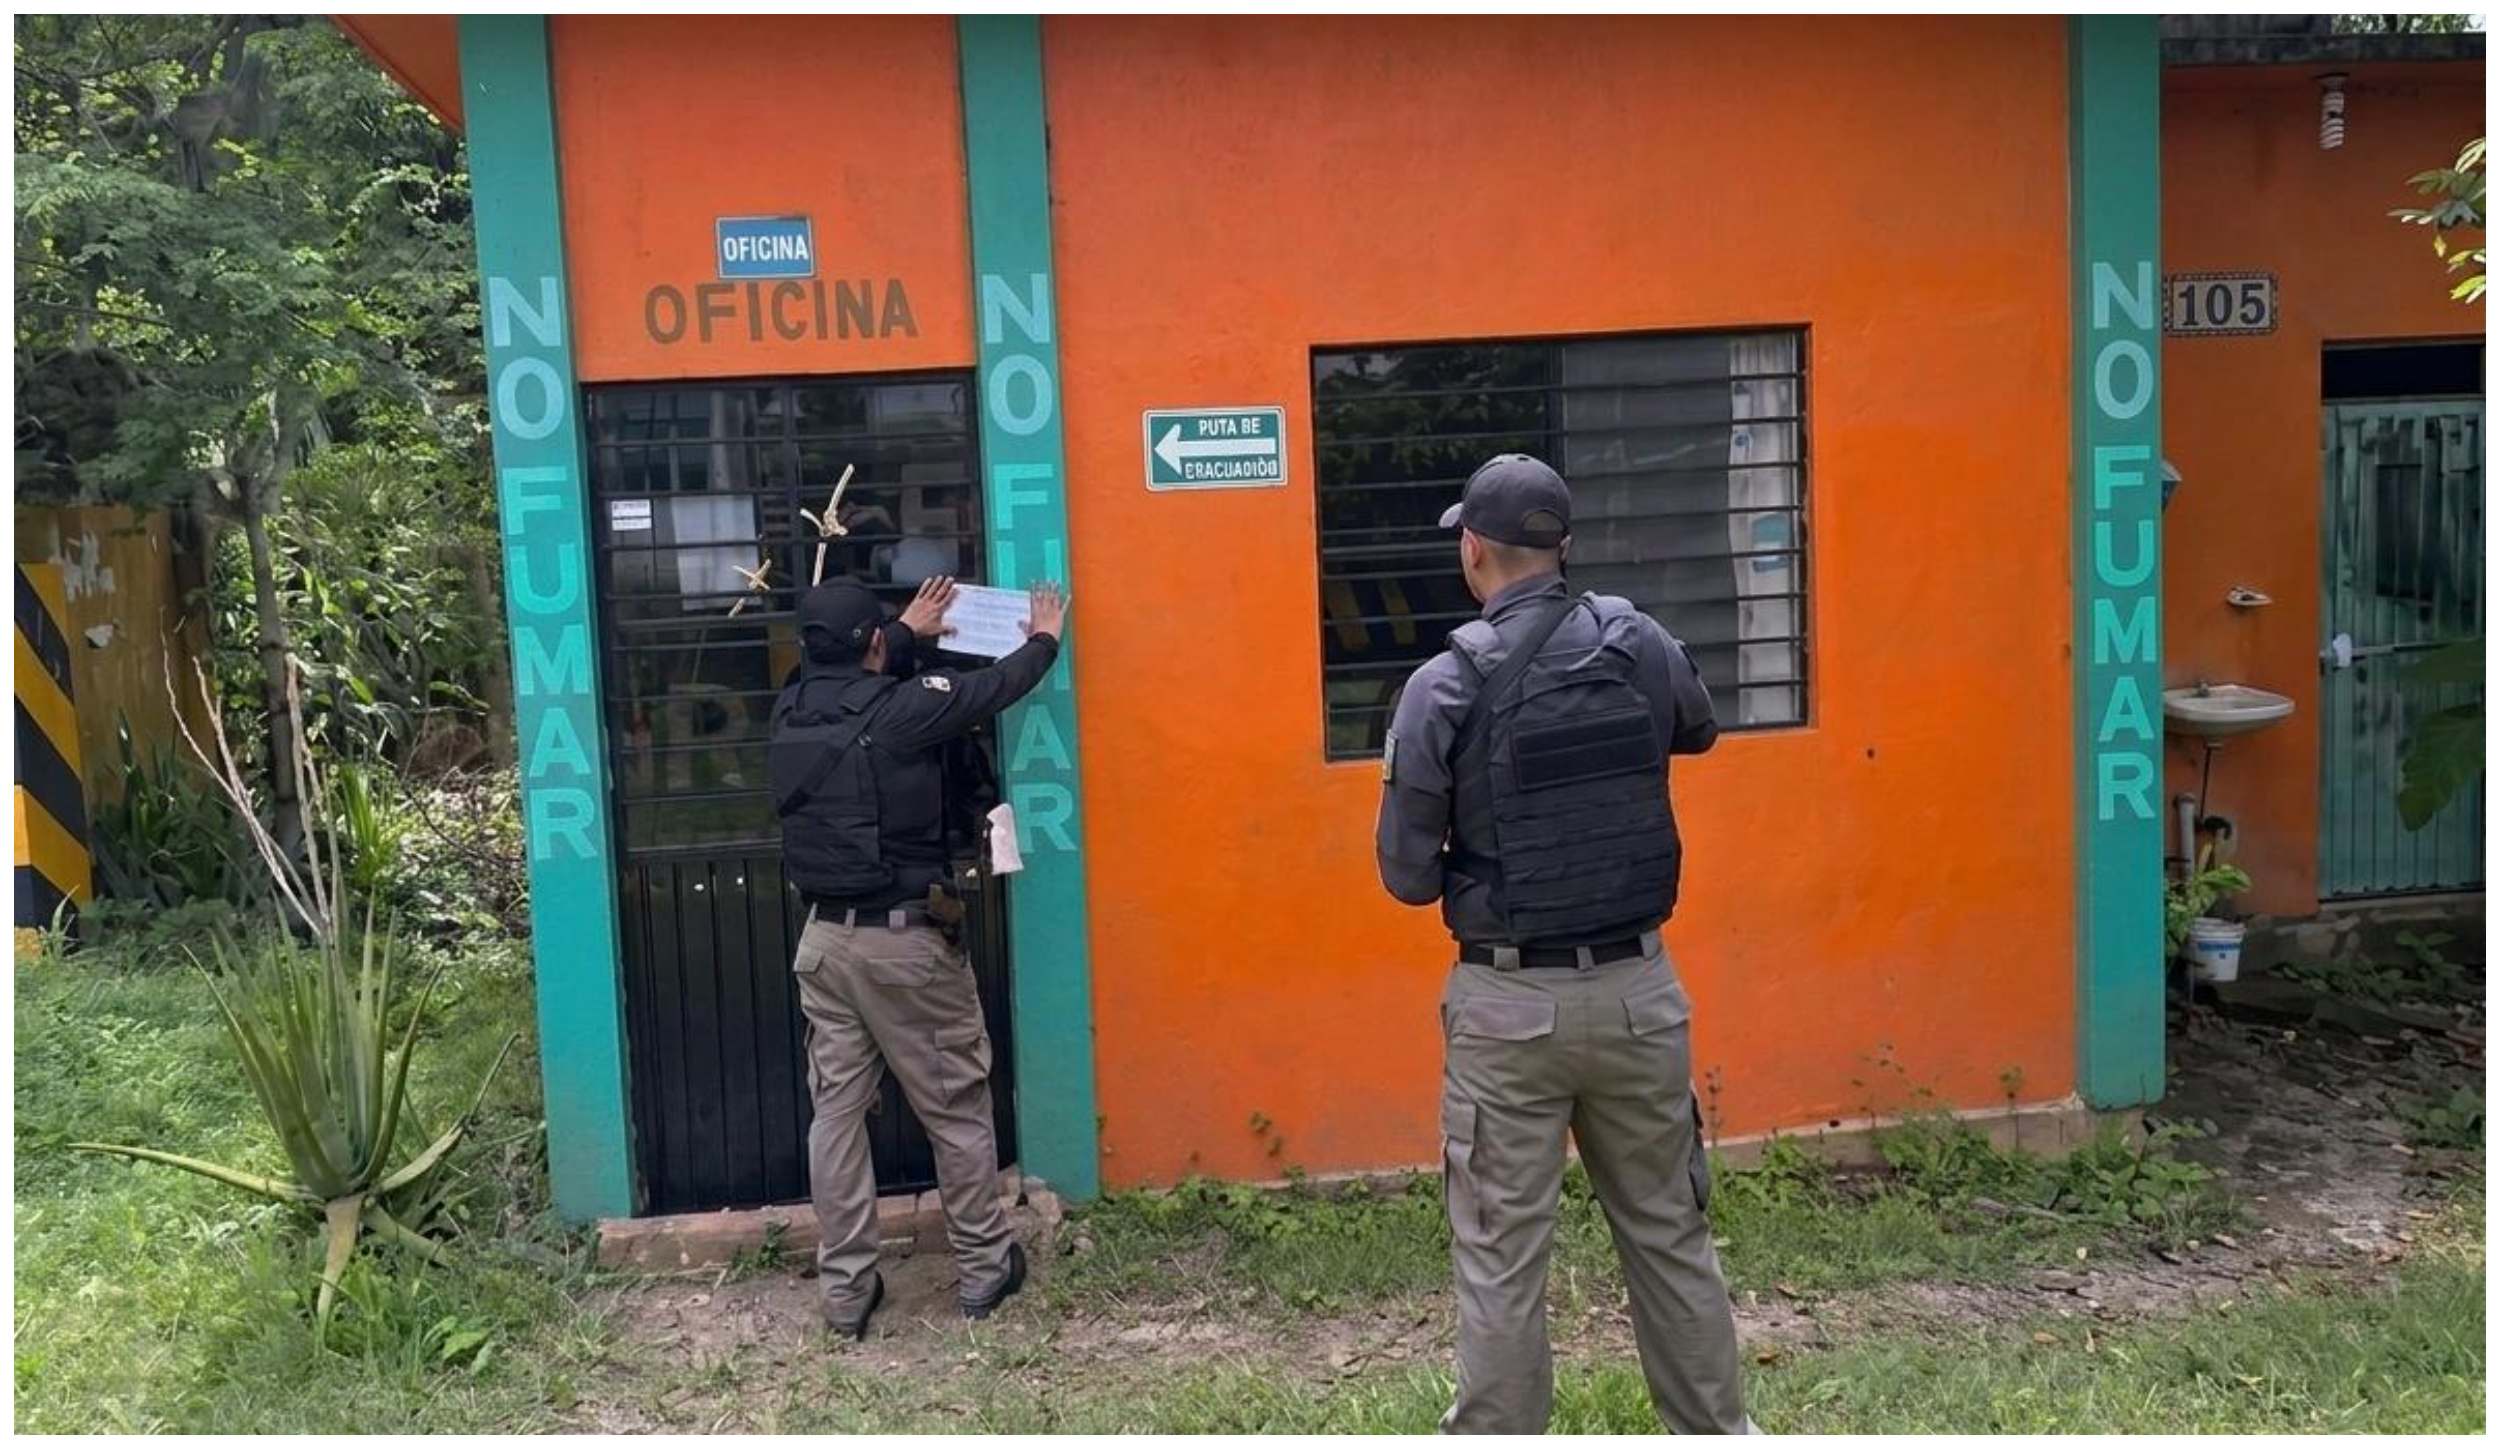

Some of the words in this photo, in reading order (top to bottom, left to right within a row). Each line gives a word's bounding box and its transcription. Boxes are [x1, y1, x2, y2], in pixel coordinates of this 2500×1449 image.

[645, 278, 918, 344] OFICINA
[723, 234, 809, 262] OFICINA
[2178, 283, 2265, 326] 105
[489, 277, 565, 440] NO
[982, 273, 1054, 435] NO
[2094, 262, 2154, 420] NO
[1199, 418, 1237, 436] PUTA
[503, 467, 597, 860] FUMAR
[992, 463, 1075, 853] FUAR
[2094, 446, 2155, 821] FUMAR
